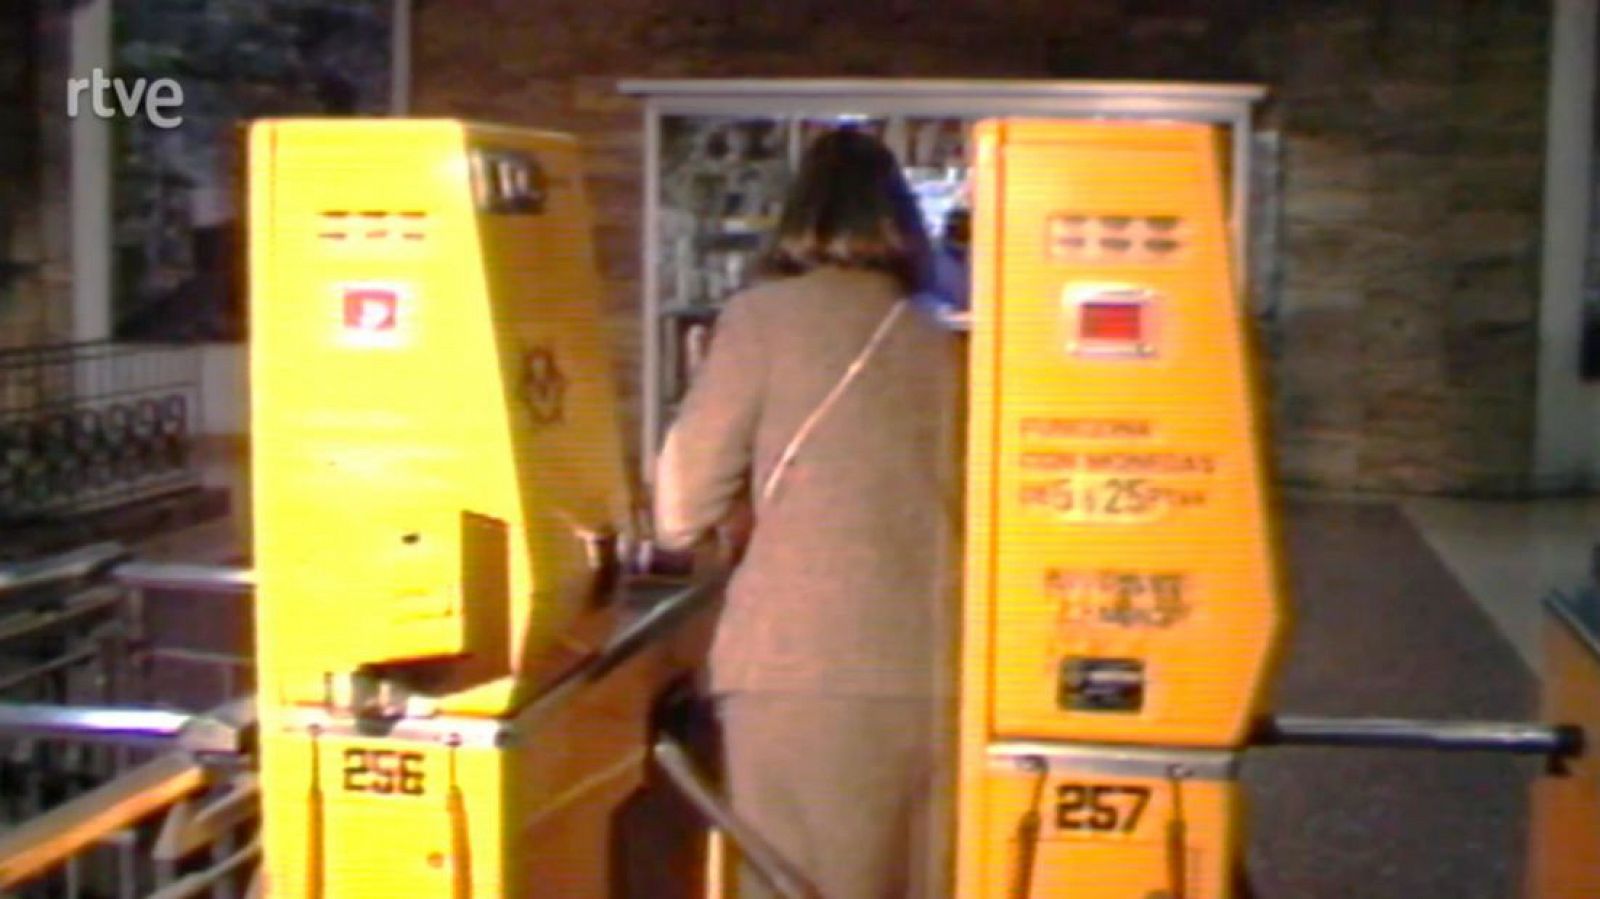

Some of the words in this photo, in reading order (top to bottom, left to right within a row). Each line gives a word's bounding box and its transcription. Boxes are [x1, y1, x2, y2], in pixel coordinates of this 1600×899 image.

[1050, 479, 1074, 513] 5
[1104, 478, 1146, 514] 25
[343, 748, 425, 797] 256
[1055, 784, 1152, 834] 257
